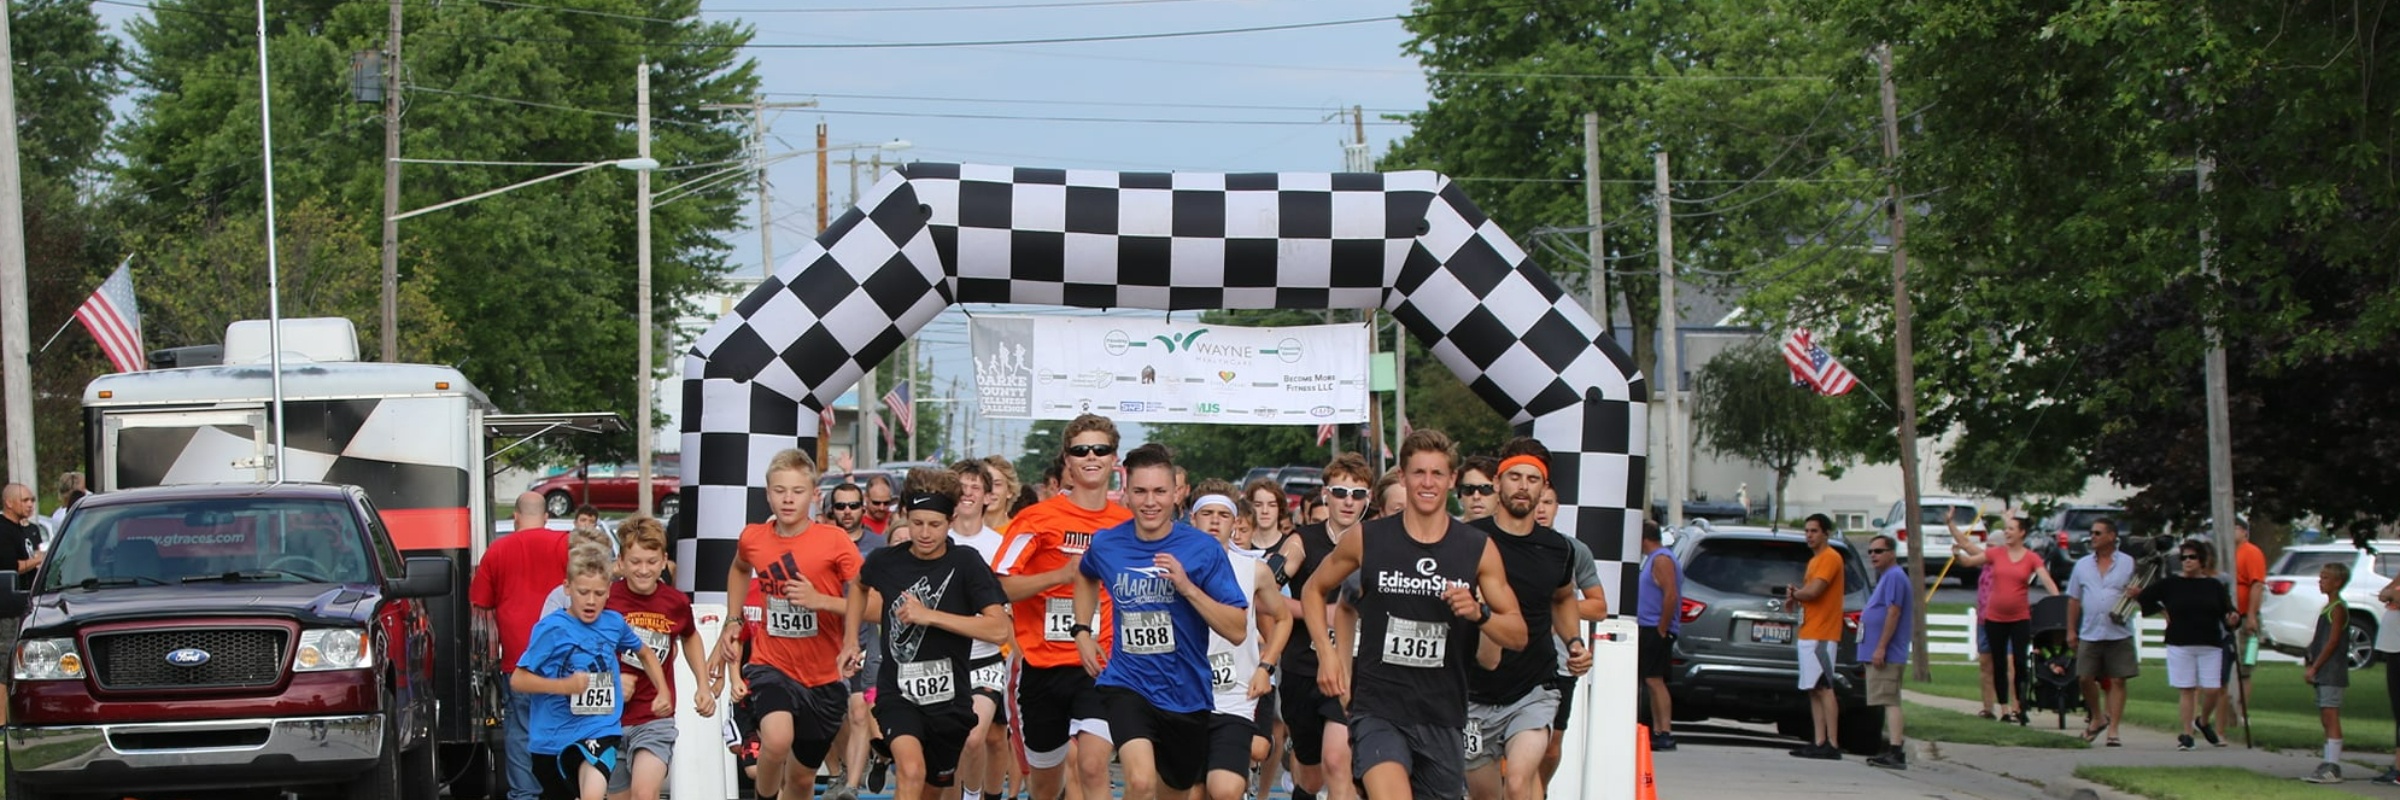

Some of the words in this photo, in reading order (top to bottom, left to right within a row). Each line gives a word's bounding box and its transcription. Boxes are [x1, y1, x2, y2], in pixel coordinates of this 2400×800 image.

[1195, 341, 1253, 358] WAYNE
[1317, 382, 1334, 391] LLC
[127, 532, 245, 547] w.gtraces.com
[1378, 586, 1432, 597] COMMUNITY
[771, 612, 813, 631] 1540
[1124, 626, 1169, 647] 1588
[1390, 636, 1438, 659] 1361
[175, 652, 200, 662] Ford
[904, 674, 950, 698] 1682
[575, 688, 612, 707] 1654
